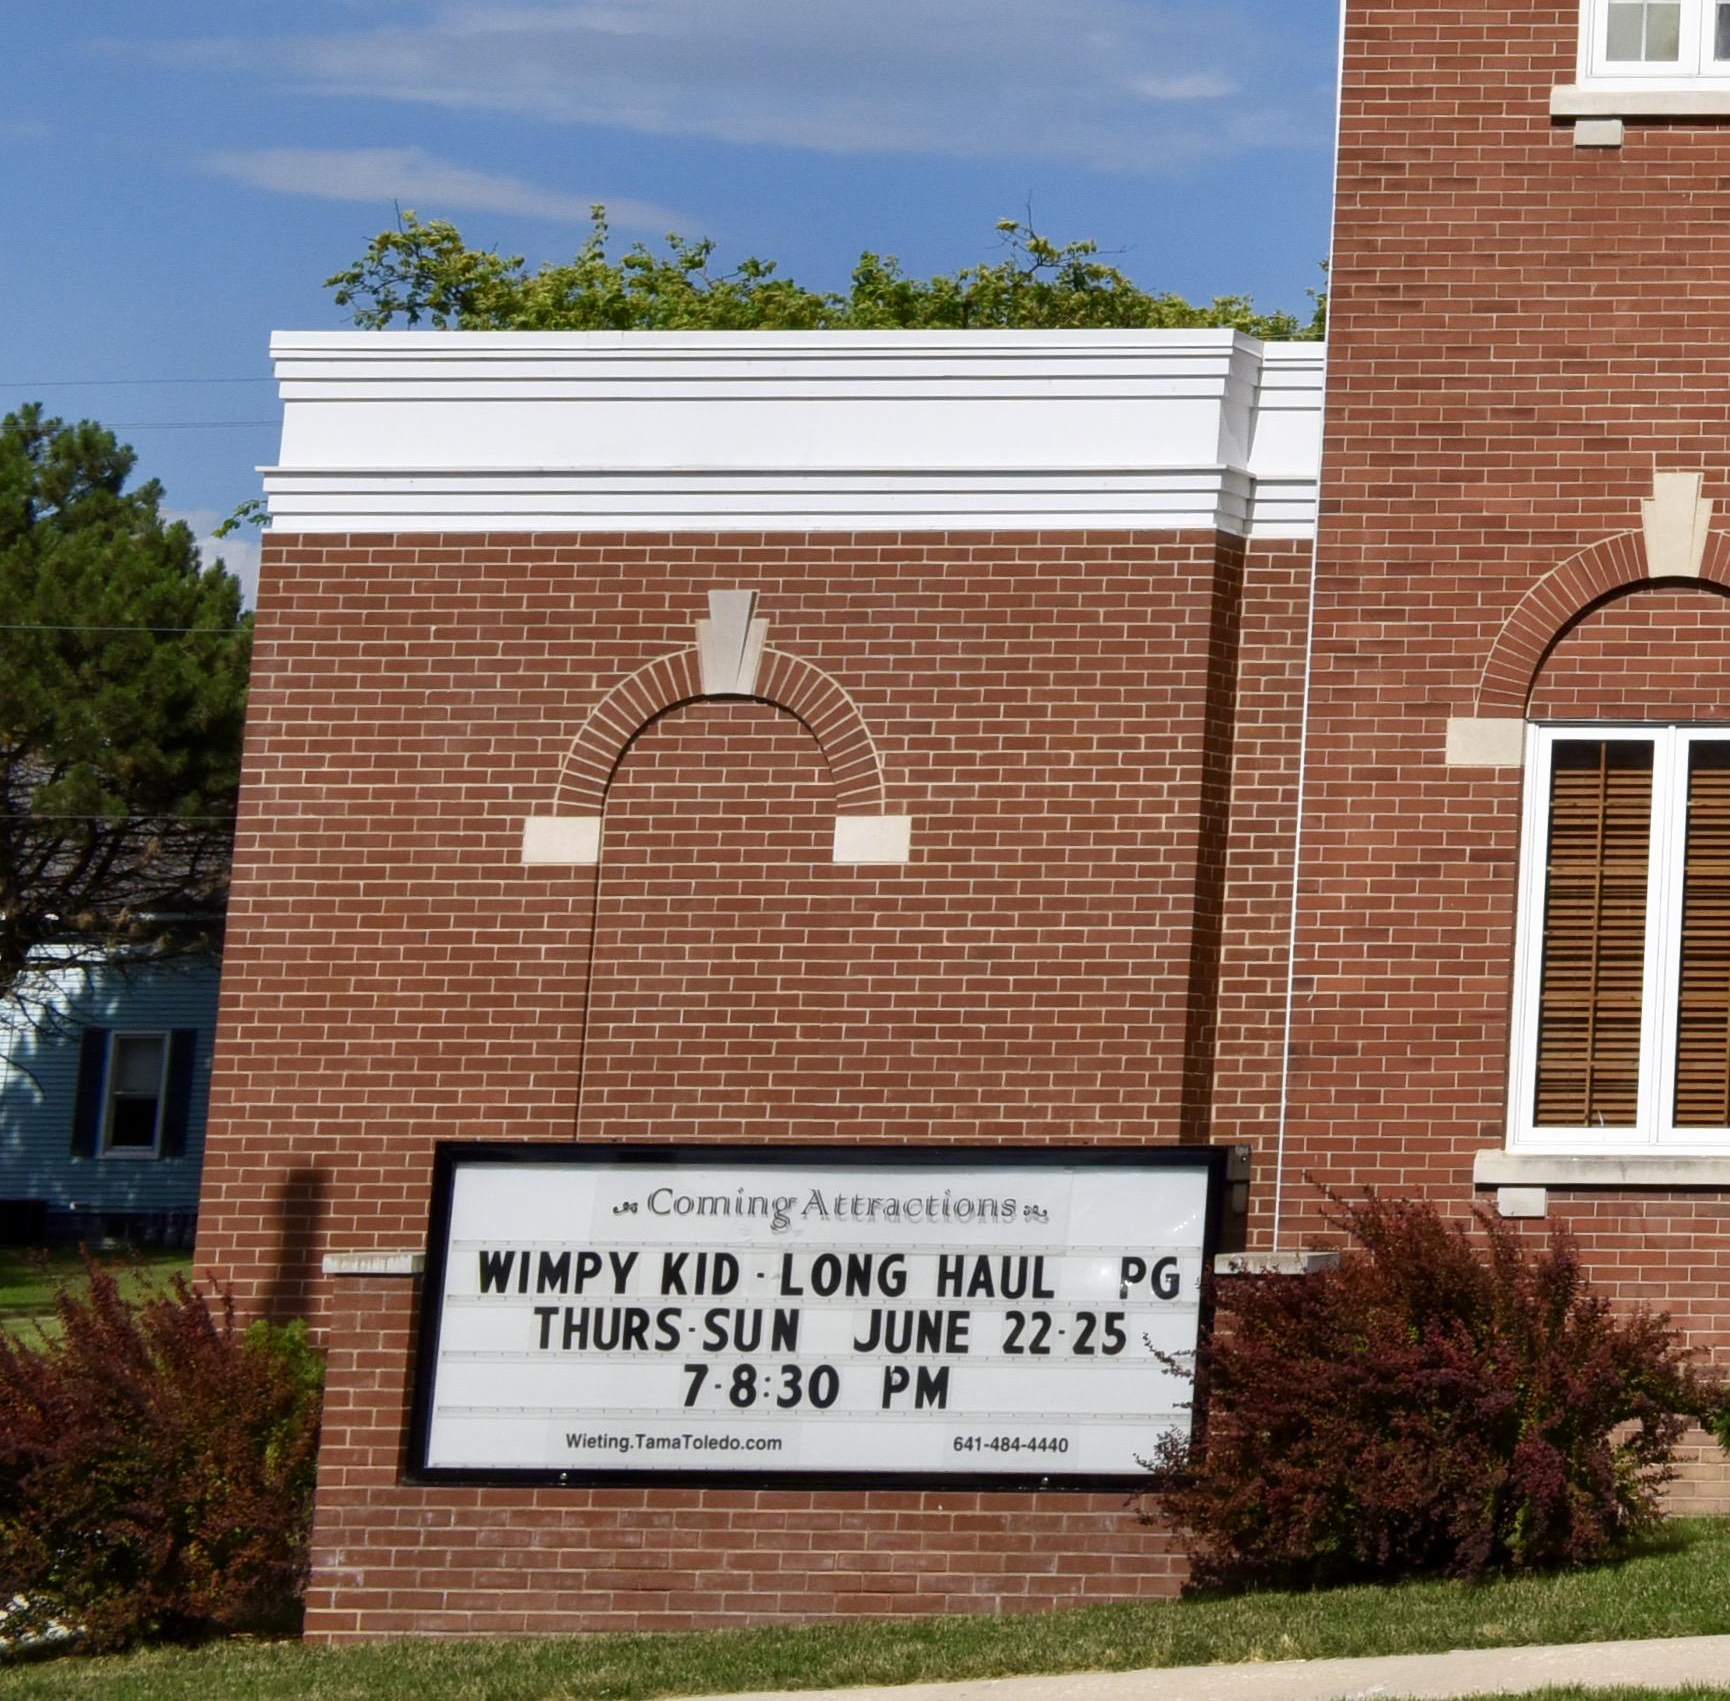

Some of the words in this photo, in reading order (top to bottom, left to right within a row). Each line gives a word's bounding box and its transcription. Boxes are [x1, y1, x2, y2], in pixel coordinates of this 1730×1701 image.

[647, 1187, 797, 1231] Coming
[800, 1187, 1017, 1219] Attractions
[479, 1250, 639, 1294] WIMPY
[661, 1252, 739, 1295] KID
[780, 1253, 907, 1298] LONG
[937, 1255, 1055, 1299] HAUL
[1119, 1256, 1180, 1300] PG
[853, 1308, 970, 1354] JUNE
[1002, 1310, 1127, 1356] 22-25
[683, 1363, 840, 1409] 7-8:30
[881, 1365, 950, 1409] PM
[565, 1432, 783, 1453] Wieting.TamaToledo.com
[953, 1436, 1069, 1453] 641-484-4440
